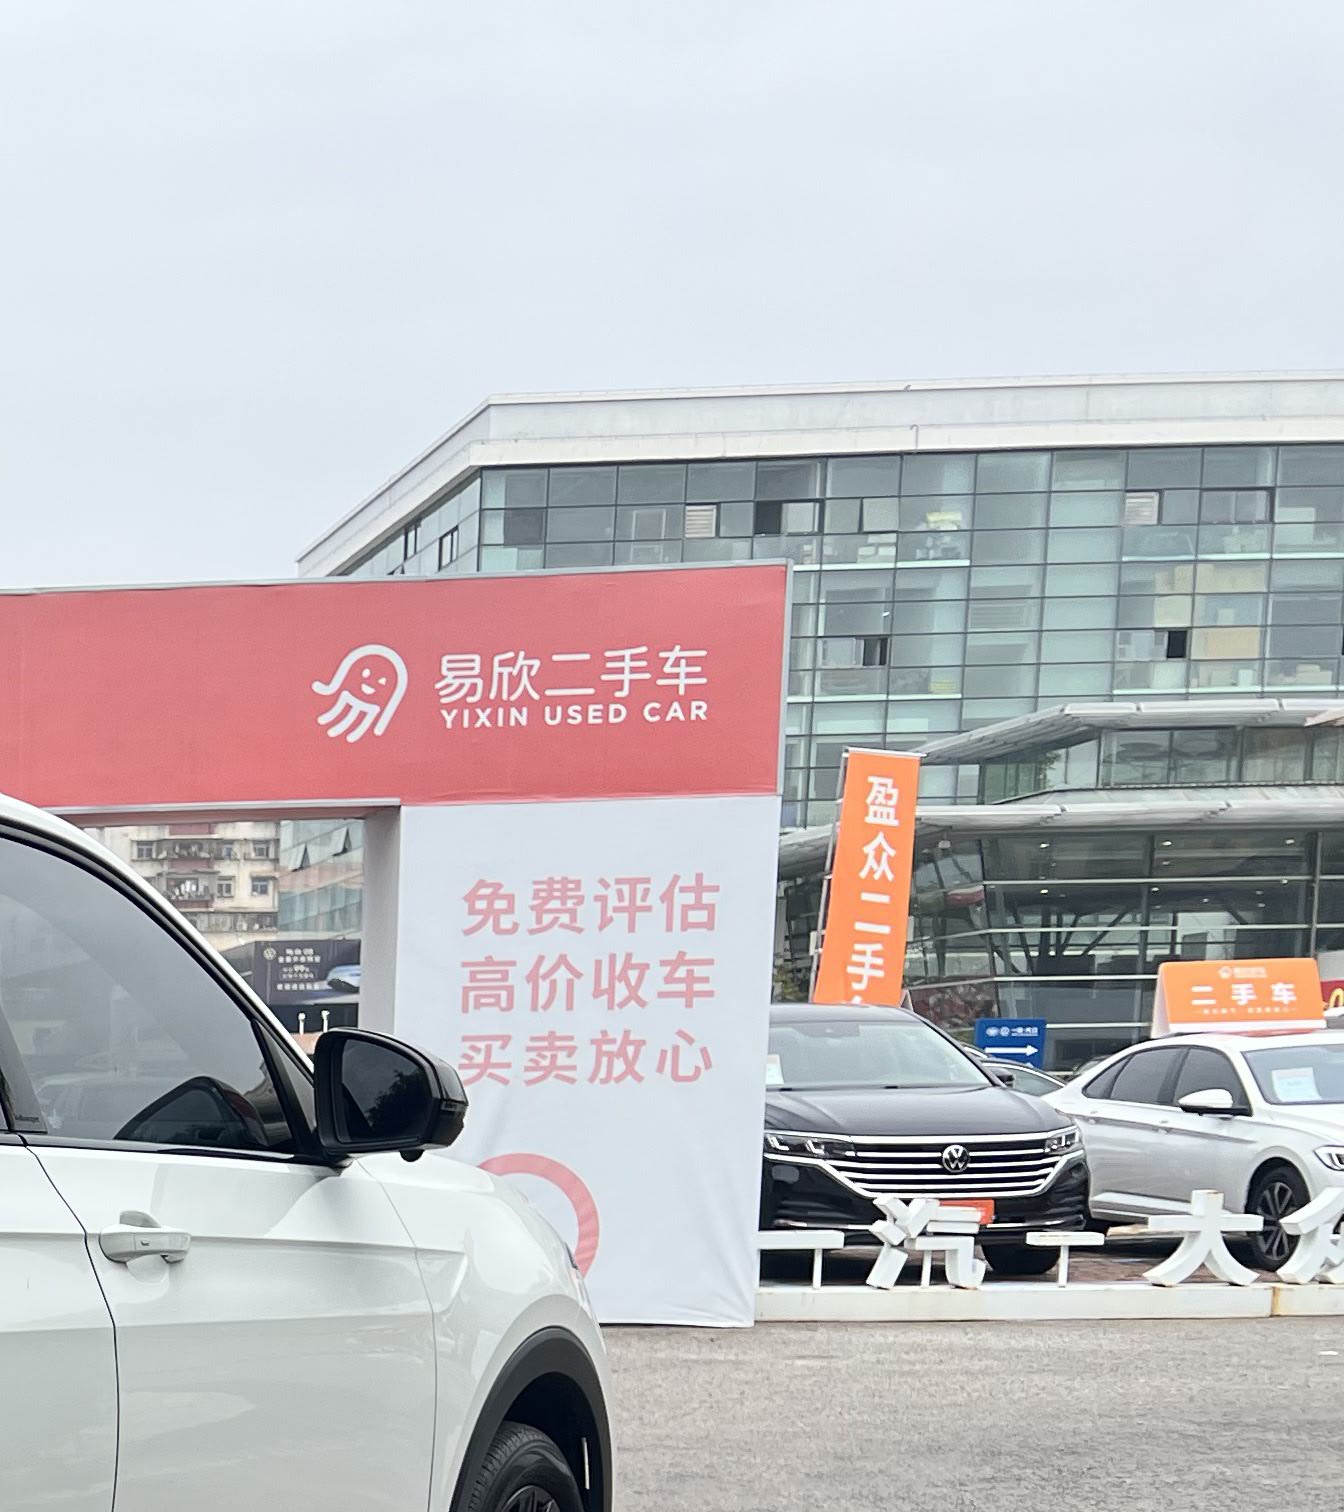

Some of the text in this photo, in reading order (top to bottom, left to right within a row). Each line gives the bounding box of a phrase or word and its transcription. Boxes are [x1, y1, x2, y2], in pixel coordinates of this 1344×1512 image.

[434, 645, 708, 704] 易欣二手车
[440, 700, 708, 729] YIXIN USED CAR
[461, 872, 721, 937] 免费评估
[842, 775, 900, 1004] 盈众二手
[460, 950, 715, 1014] 高价收车
[1191, 981, 1297, 1006] 二手车
[458, 1028, 714, 1087] 买卖放心
